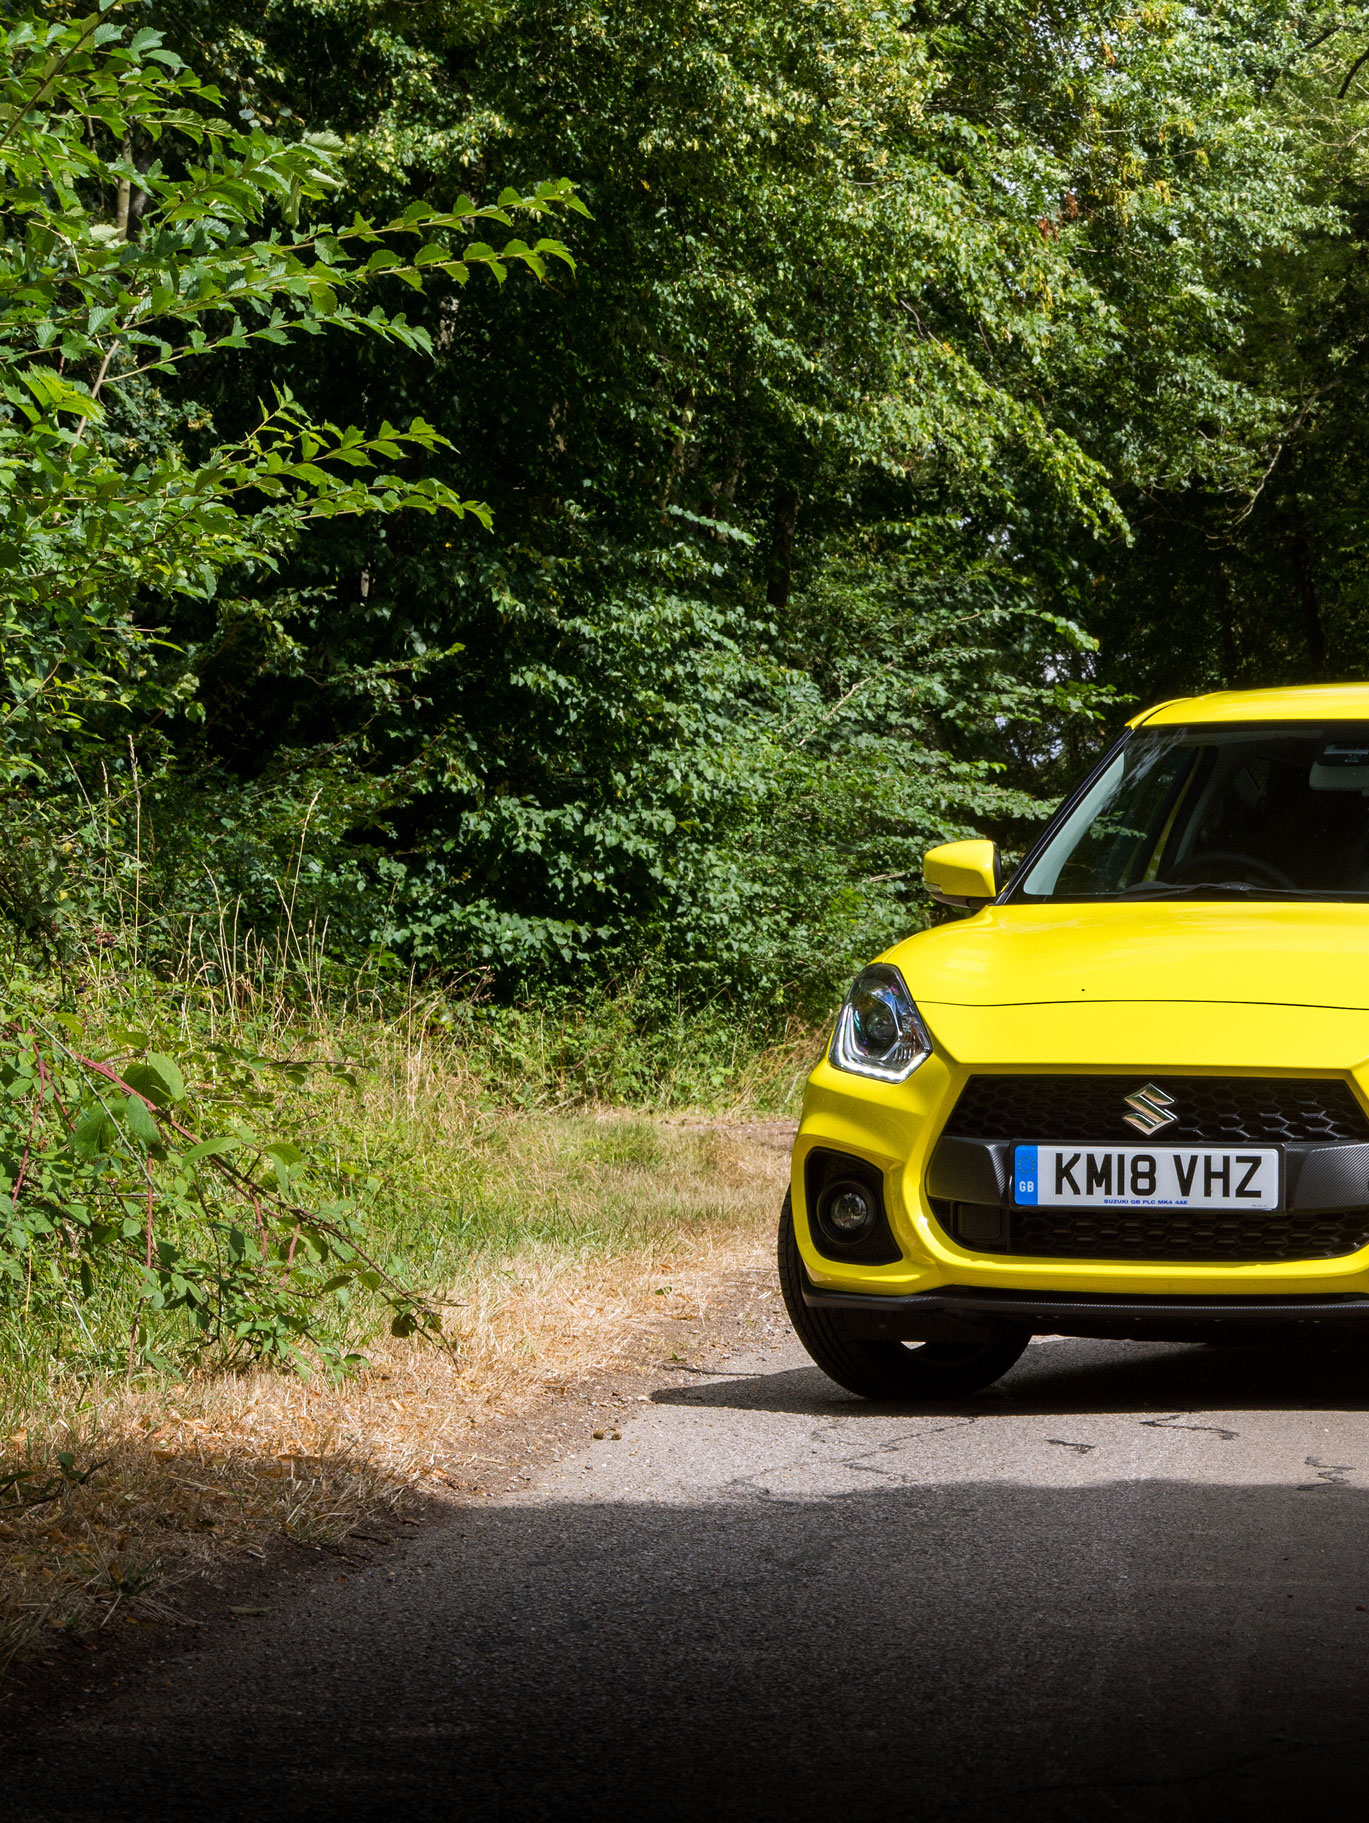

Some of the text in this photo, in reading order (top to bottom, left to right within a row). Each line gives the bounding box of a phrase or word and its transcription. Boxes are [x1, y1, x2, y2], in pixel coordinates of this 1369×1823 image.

[1019, 1180, 1035, 1193] GB
[1055, 1153, 1262, 1198] KM18 VHZ
